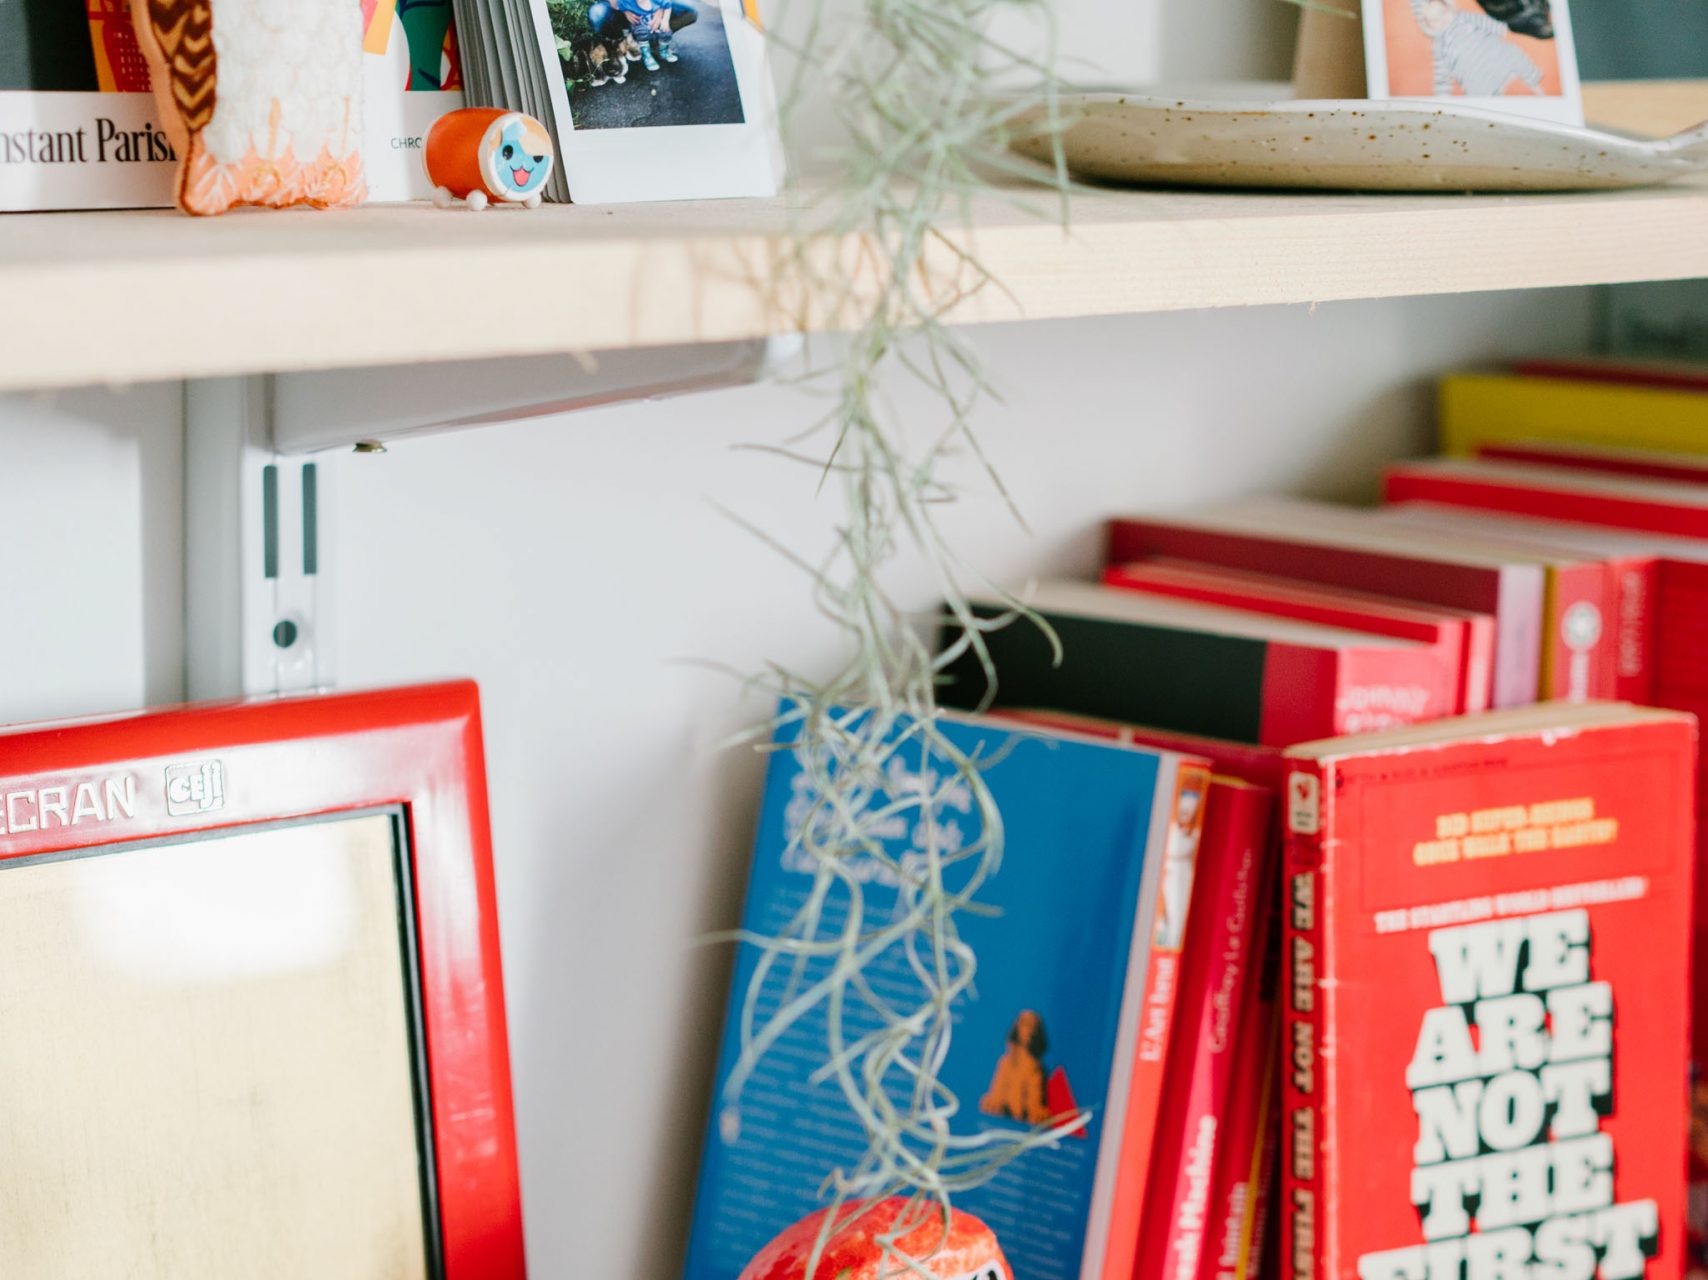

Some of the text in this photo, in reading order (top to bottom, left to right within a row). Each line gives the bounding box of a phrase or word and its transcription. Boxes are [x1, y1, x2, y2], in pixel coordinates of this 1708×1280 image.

[0, 776, 135, 835] CRAN
[1292, 872, 1314, 930] WE
[1293, 934, 1314, 1012] ARE
[1428, 908, 1591, 1005] WE
[1293, 1020, 1314, 1093] NOT
[1405, 981, 1612, 1089] ARE
[1293, 1107, 1314, 1180] THE
[1412, 1058, 1613, 1166] NOT
[1410, 1132, 1613, 1243] THE
